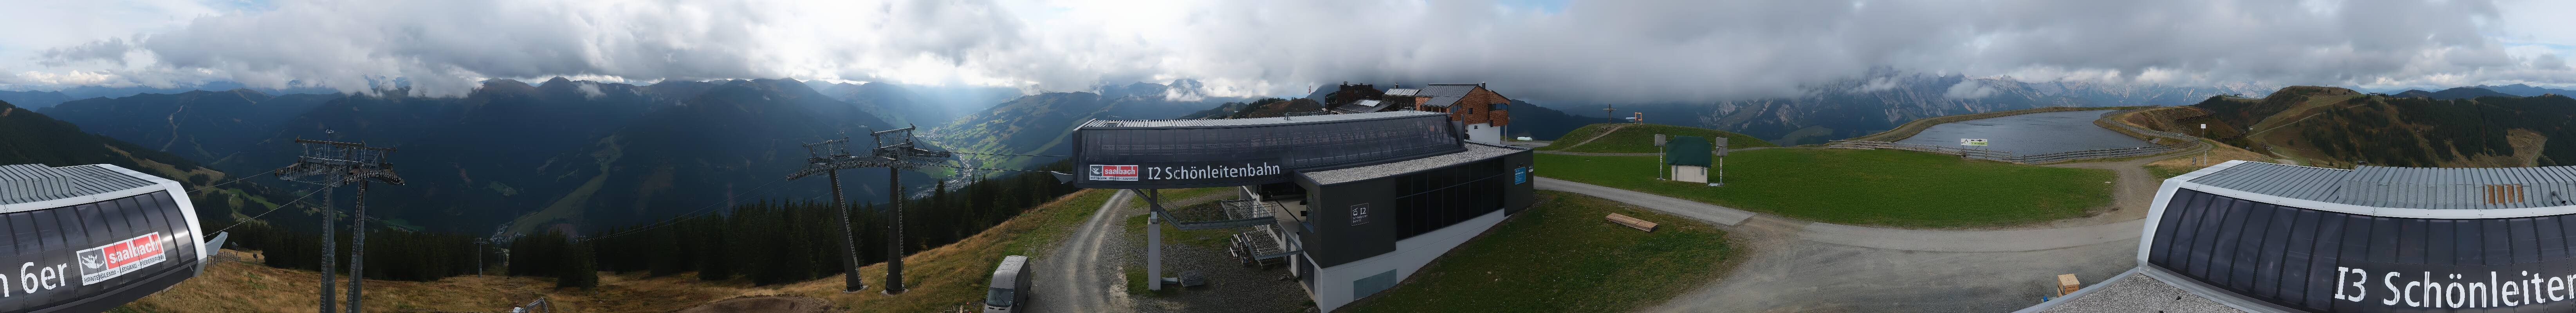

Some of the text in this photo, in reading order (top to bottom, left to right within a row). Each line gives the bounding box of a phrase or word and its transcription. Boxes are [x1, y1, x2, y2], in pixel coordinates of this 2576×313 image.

[1105, 166, 1135, 174] saalbach
[1148, 162, 1280, 180] I2 Schönleitenbahn
[109, 235, 159, 264] saalbach
[21, 262, 67, 293] 6er
[121, 263, 137, 273] LEOGANG
[2334, 266, 2367, 302] I3
